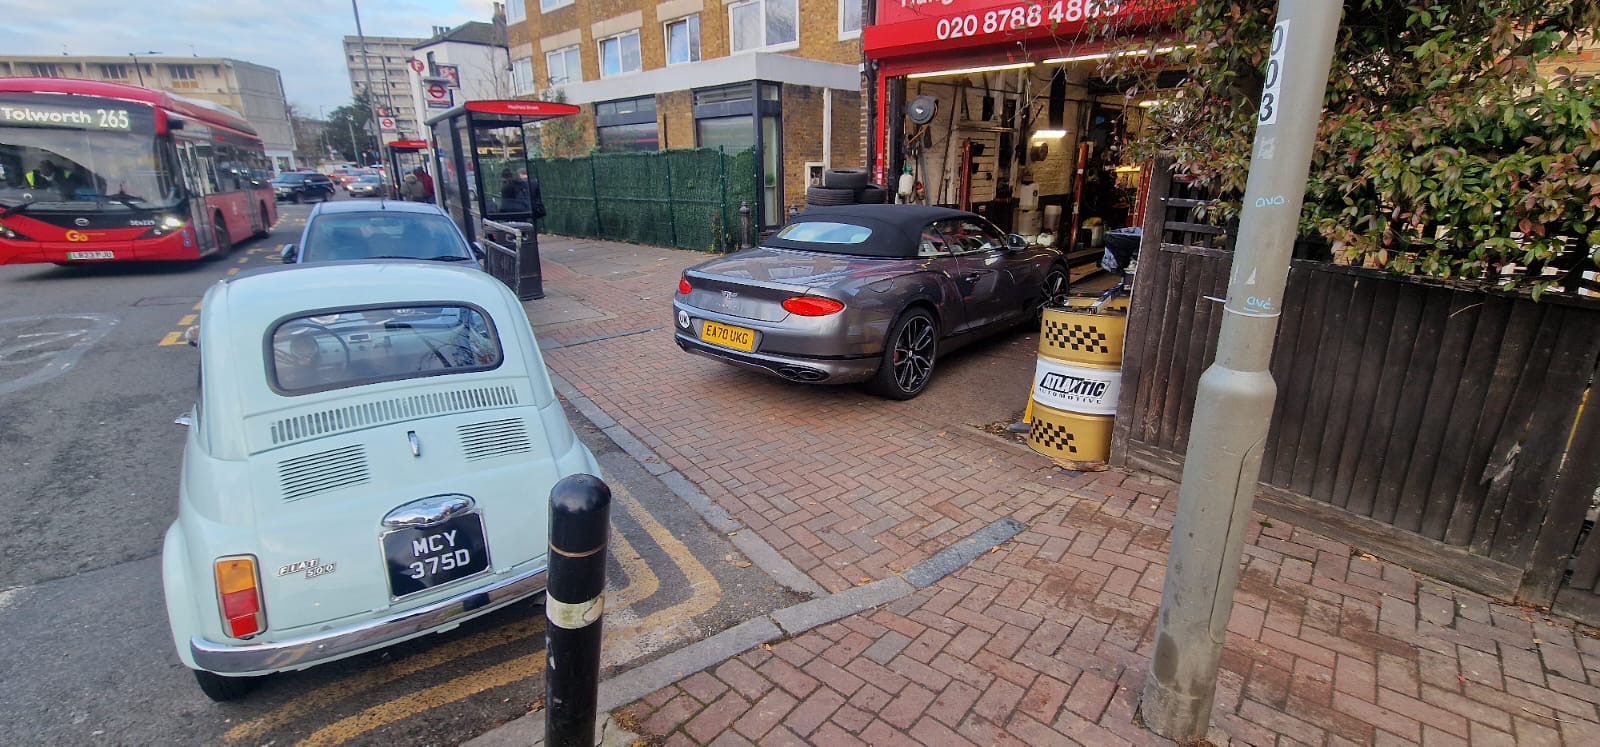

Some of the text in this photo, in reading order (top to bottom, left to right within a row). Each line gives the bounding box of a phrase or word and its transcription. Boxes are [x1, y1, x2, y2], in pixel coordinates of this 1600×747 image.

[936, 14, 978, 40] 020
[983, 4, 1042, 34] 8788
[0, 106, 129, 129] Tolworth 265
[66, 230, 88, 241] Go
[706, 325, 749, 345] EA70 UKG
[1042, 374, 1106, 397] ATLANTIC
[412, 529, 457, 557] MCY
[278, 558, 318, 577] FIAT
[305, 563, 336, 579] 500
[409, 548, 470, 579] 375D
